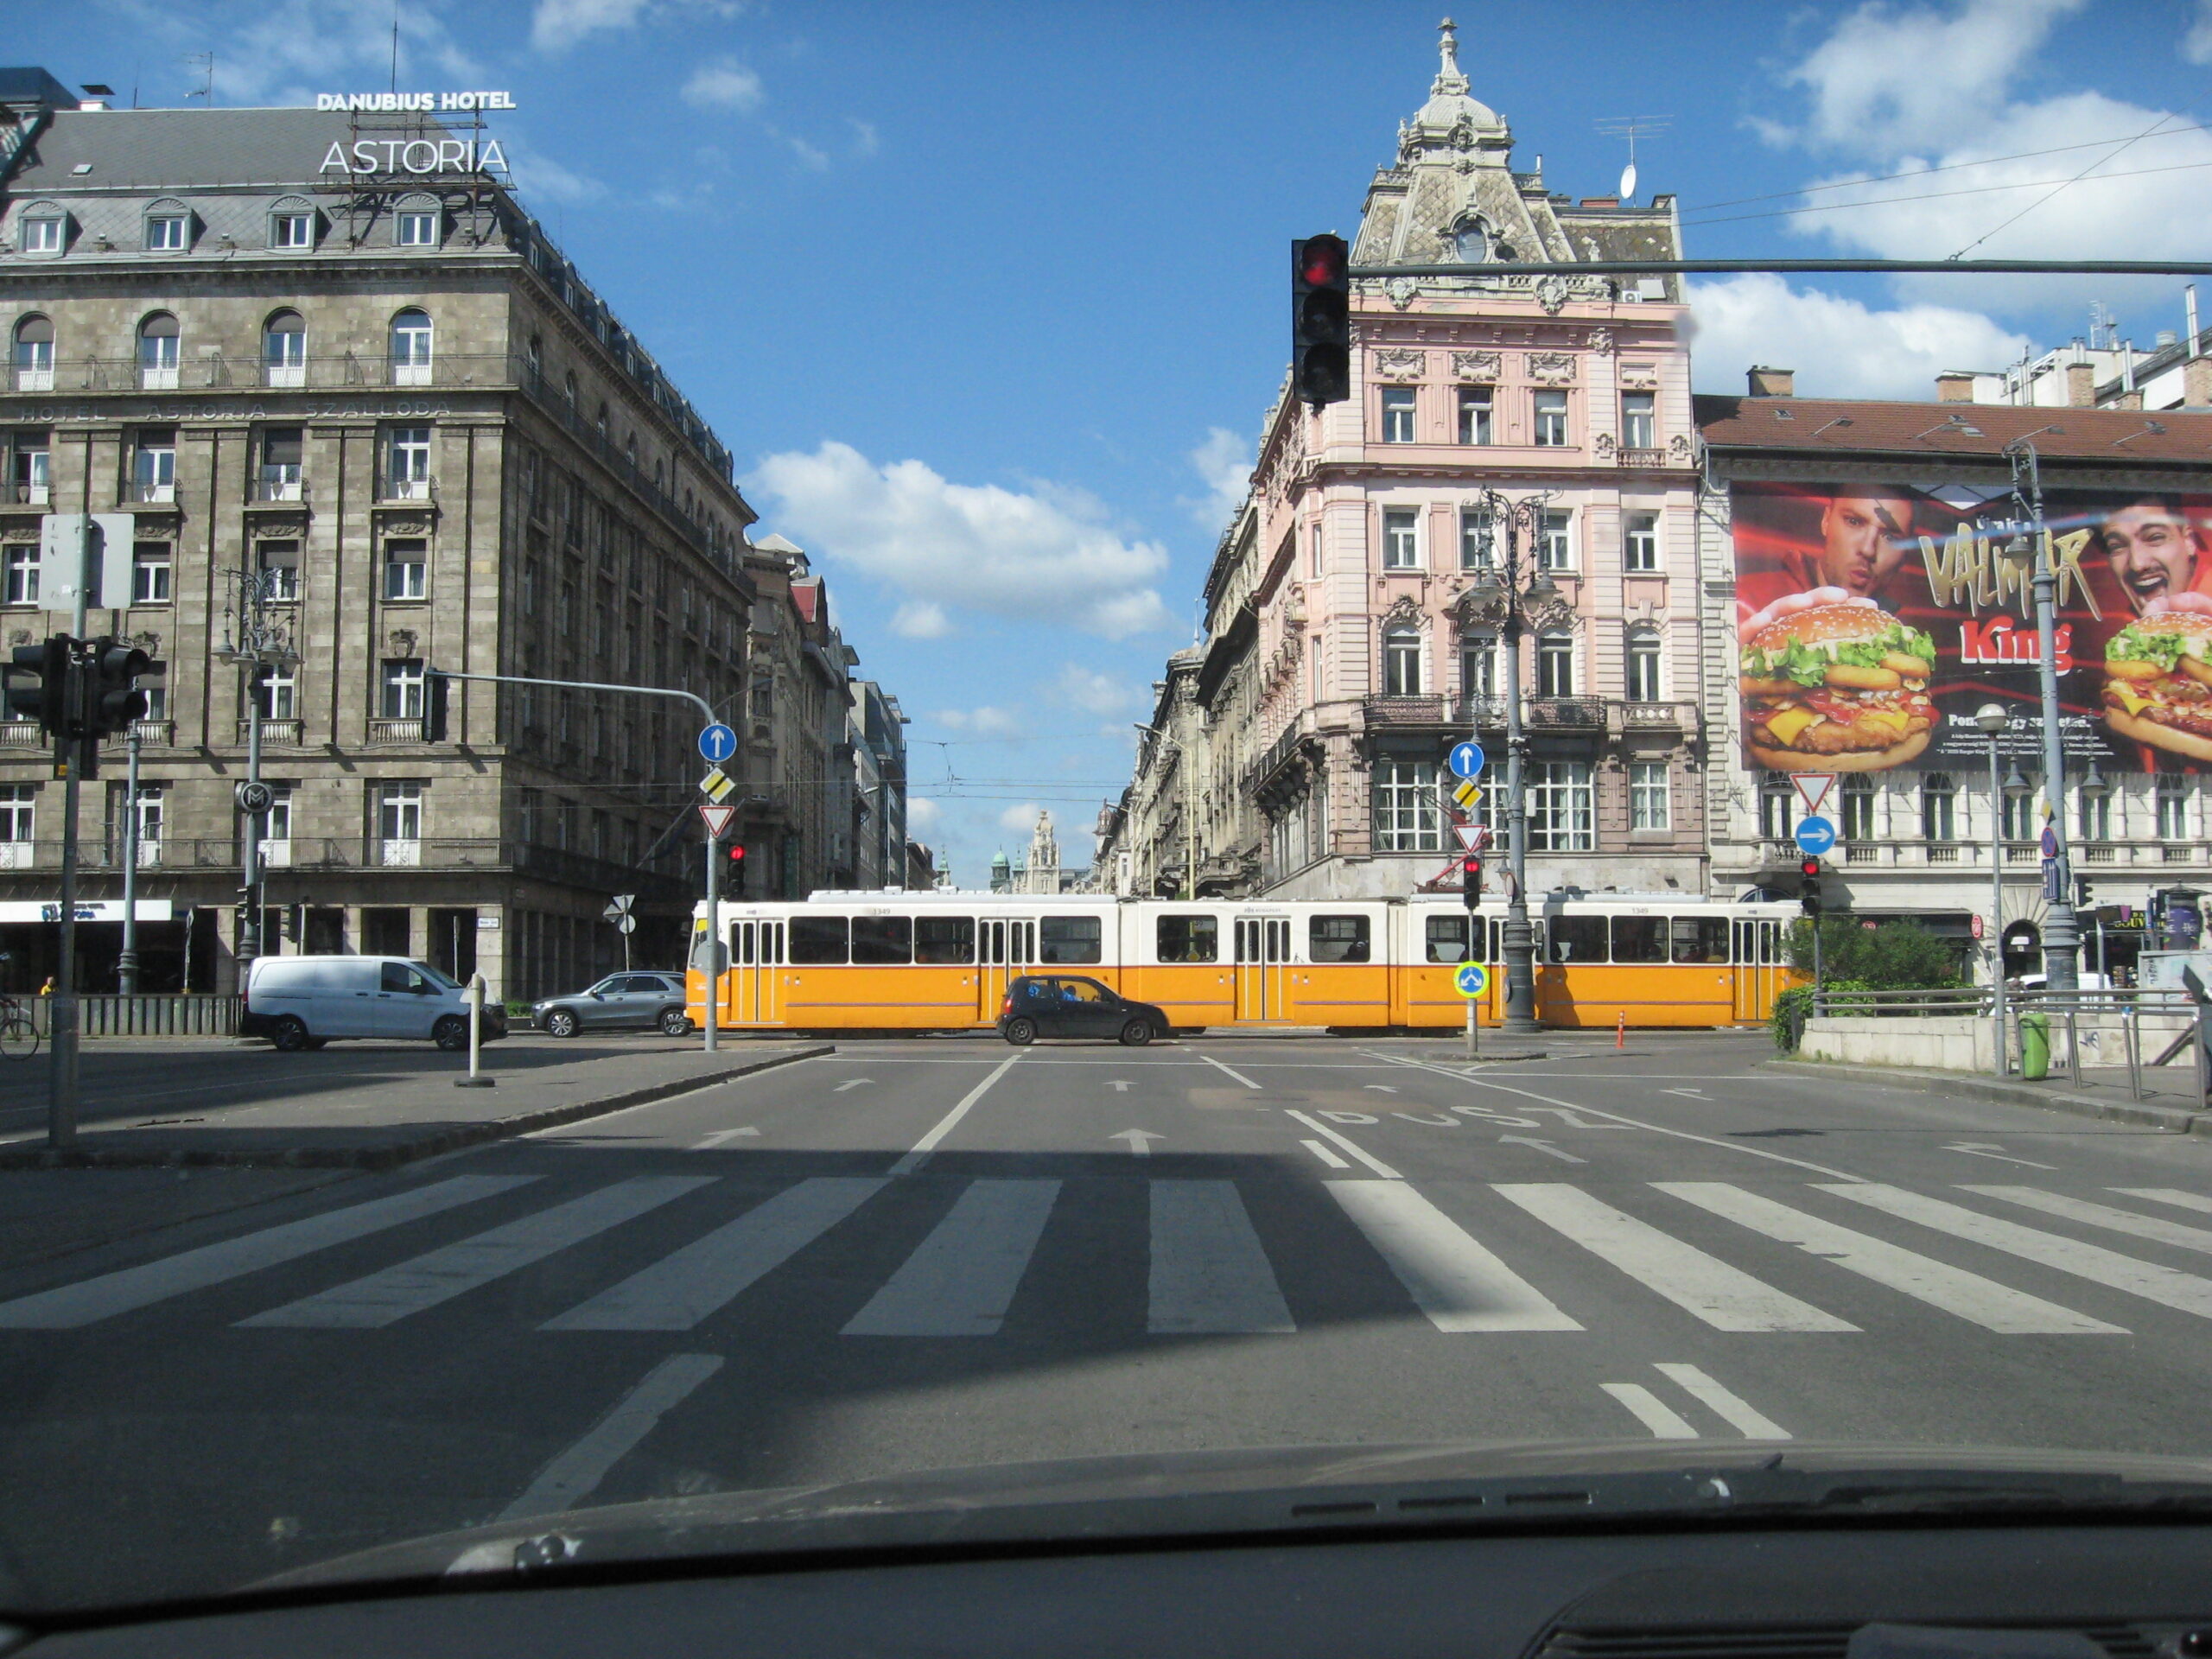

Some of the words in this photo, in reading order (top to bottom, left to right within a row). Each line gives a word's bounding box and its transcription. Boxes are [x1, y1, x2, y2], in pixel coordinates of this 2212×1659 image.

[317, 92, 435, 111] DANUBIUS
[442, 92, 517, 111] HOTEL
[319, 139, 508, 174] ASTORIA
[21, 406, 107, 423] HOTEL
[146, 403, 267, 421] ASTORIA
[1959, 615, 2074, 677] King
